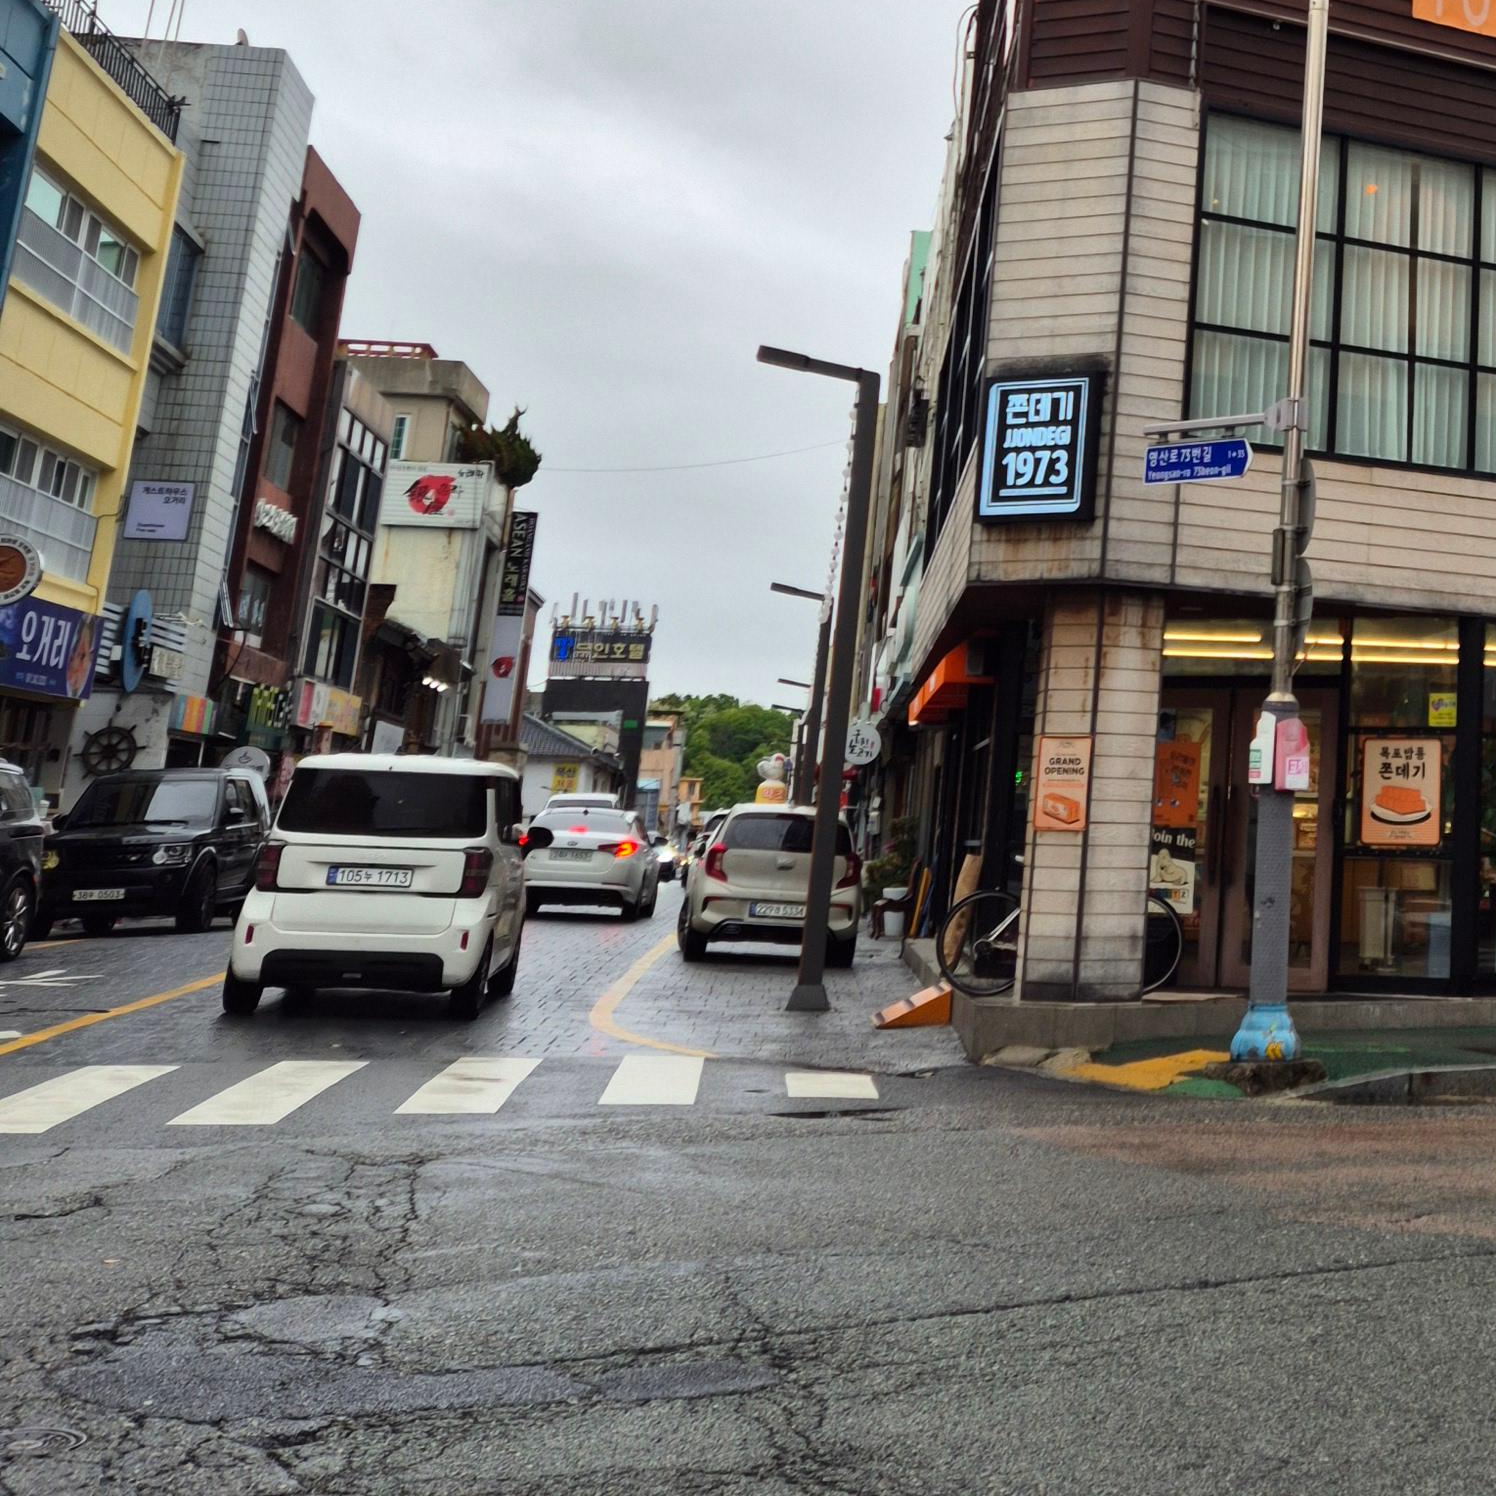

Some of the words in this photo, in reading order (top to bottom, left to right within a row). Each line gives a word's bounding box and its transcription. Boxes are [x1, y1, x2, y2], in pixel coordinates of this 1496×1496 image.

[1006, 391, 1074, 424] 쫀데기
[1003, 425, 1072, 448] JJONDEGI
[1002, 449, 1069, 486] 1973
[509, 514, 529, 557] ASEAN
[16, 611, 72, 669] 오거리
[1049, 757, 1081, 765] GRAND
[1379, 747, 1426, 760] 목포밥통
[1044, 767, 1085, 775] OPENING
[1379, 762, 1426, 780] 쫀데기
[1176, 833, 1196, 849] the
[377, 871, 409, 884] 1713
